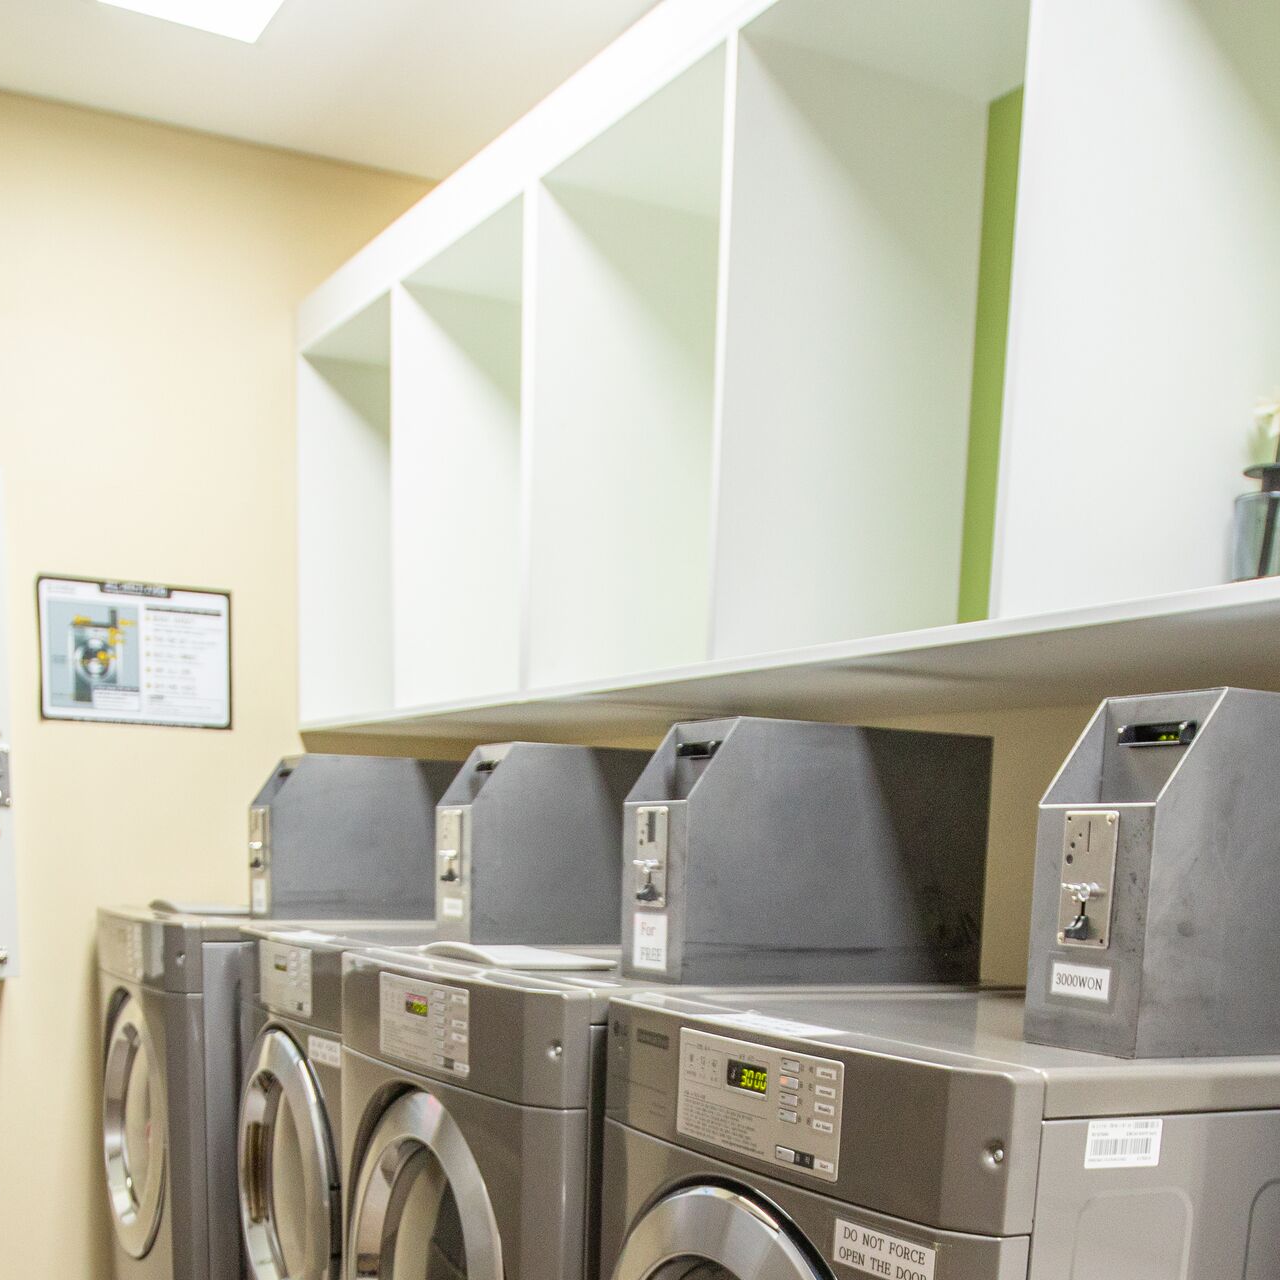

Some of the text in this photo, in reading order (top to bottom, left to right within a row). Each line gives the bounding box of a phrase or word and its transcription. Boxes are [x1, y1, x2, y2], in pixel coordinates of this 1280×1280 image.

[640, 921, 656, 936] For
[640, 946, 662, 962] FREE
[1055, 972, 1103, 991] 3000WON
[843, 1226, 926, 1265] DO NOT FORCE
[839, 1246, 865, 1266] OPEN
[870, 1257, 892, 1276] THE
